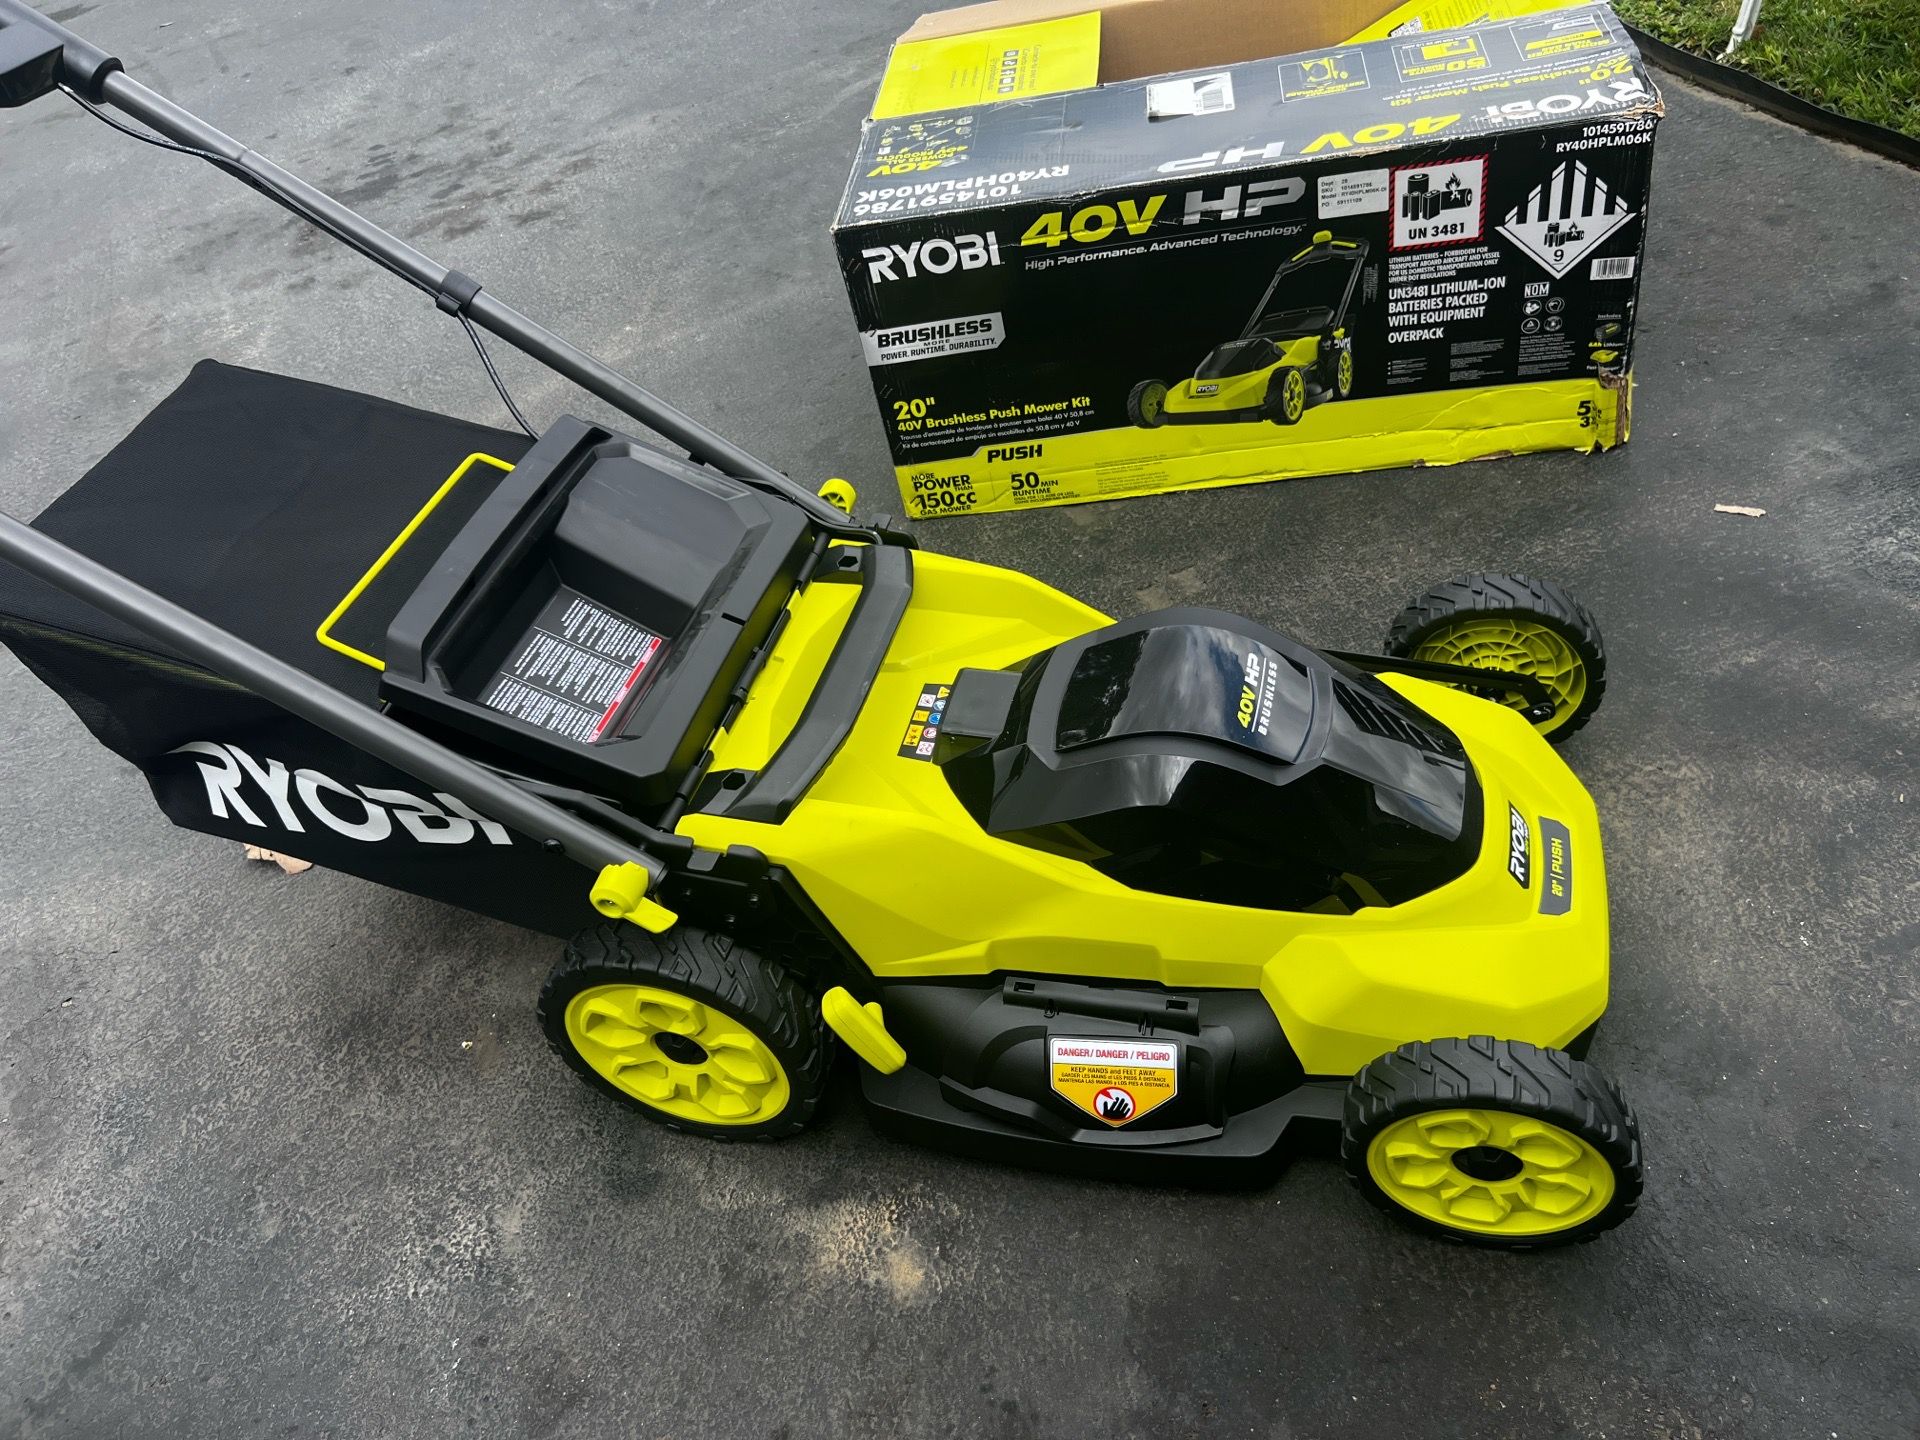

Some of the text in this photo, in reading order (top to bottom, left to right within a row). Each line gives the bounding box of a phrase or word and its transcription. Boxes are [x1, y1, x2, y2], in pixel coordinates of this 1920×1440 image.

[1415, 88, 1468, 102] Mower
[1472, 80, 1510, 92] Push
[1390, 98, 1412, 107] Kit
[1486, 77, 1651, 123] RYOBI
[1582, 120, 1653, 137] 1014591786
[1156, 113, 1461, 172] 40V HP
[1556, 132, 1652, 152] RY40HPLM06K
[866, 160, 943, 178] 40V
[856, 164, 1070, 204] RY40HPLM06K
[853, 184, 1022, 217] 1014591786
[1021, 177, 1306, 248] 40V HP
[1408, 222, 1465, 240] UN 3481
[862, 231, 1000, 284] RYOBI
[1025, 256, 1054, 270] High
[1057, 246, 1148, 266] Performance.
[1150, 235, 1218, 252] Advanced
[1412, 252, 1439, 261] BATTERIES
[1444, 248, 1476, 257] FORBIDDEN
[1554, 249, 1564, 262] 9
[1409, 266, 1435, 274] DOMESTIC
[1436, 261, 1484, 271] TRANSPORTATION
[1420, 270, 1456, 280] REGULATIONS
[1389, 276, 1506, 300] UN3481 LITHIUM-ION
[1525, 283, 1549, 297] NOM
[1389, 292, 1488, 314] BATTERIES PACKED
[1388, 306, 1486, 327] WITH EQUIPMENT
[878, 318, 992, 348] BRUSHLESS
[1388, 327, 1444, 343] OVERPACK
[881, 338, 996, 360] POWER. RUNTIME. DURABILITY.
[893, 397, 935, 420] 20"
[898, 397, 1090, 431] 40V Brushless Push Mower Kit
[1577, 400, 1591, 416] 5
[1580, 416, 1591, 428] 3
[965, 433, 986, 441] empuje
[988, 444, 1042, 463] PUSH
[911, 473, 935, 481] MORE
[913, 475, 970, 492] POWER
[1011, 472, 1039, 490] 50
[920, 491, 977, 510] 150cc
[1013, 488, 1051, 496] RUNTIME
[920, 505, 972, 515] GAS MOWER
[1237, 653, 1260, 728] 40V HP
[1258, 661, 1278, 736] BRUSHLESS
[163, 741, 514, 845] RYOBI
[1510, 807, 1525, 882] RYOBI
[1551, 837, 1563, 897] 20" PUSH
[1096, 1049, 1129, 1060] DANGER
[1136, 1051, 1170, 1061] PELIGRO
